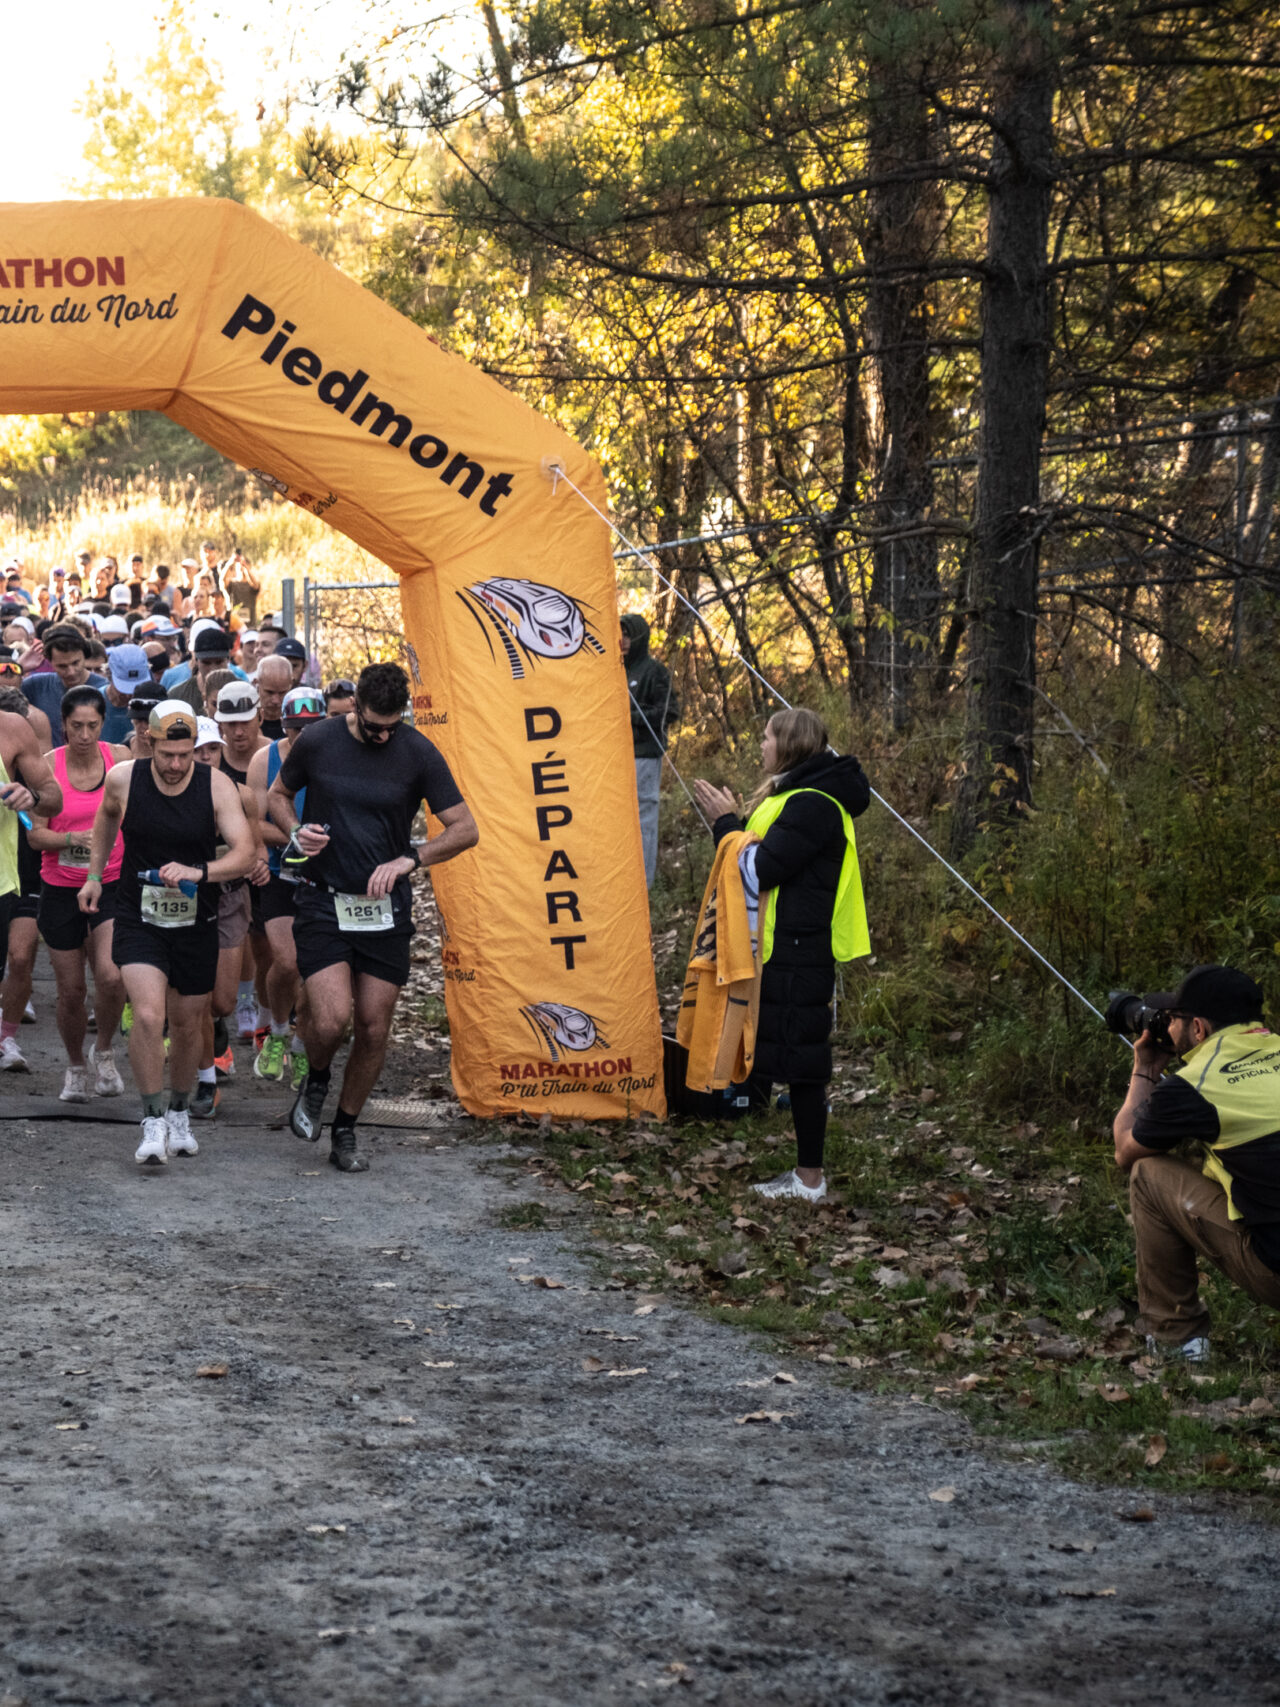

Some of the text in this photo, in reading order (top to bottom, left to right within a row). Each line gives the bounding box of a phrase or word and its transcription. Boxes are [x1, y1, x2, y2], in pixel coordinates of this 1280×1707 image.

[50, 297, 91, 324] du
[96, 293, 179, 328] Nord
[221, 293, 515, 518] Piedmont
[524, 706, 587, 971] DÉPART
[151, 901, 189, 913] 1135
[345, 905, 382, 917] 1261
[500, 1057, 633, 1080] MARATHON
[1227, 1069, 1272, 1084] OFFICIAL
[542, 1079, 589, 1097] Train
[592, 1081, 615, 1094] du
[618, 1072, 656, 1094] Nord
